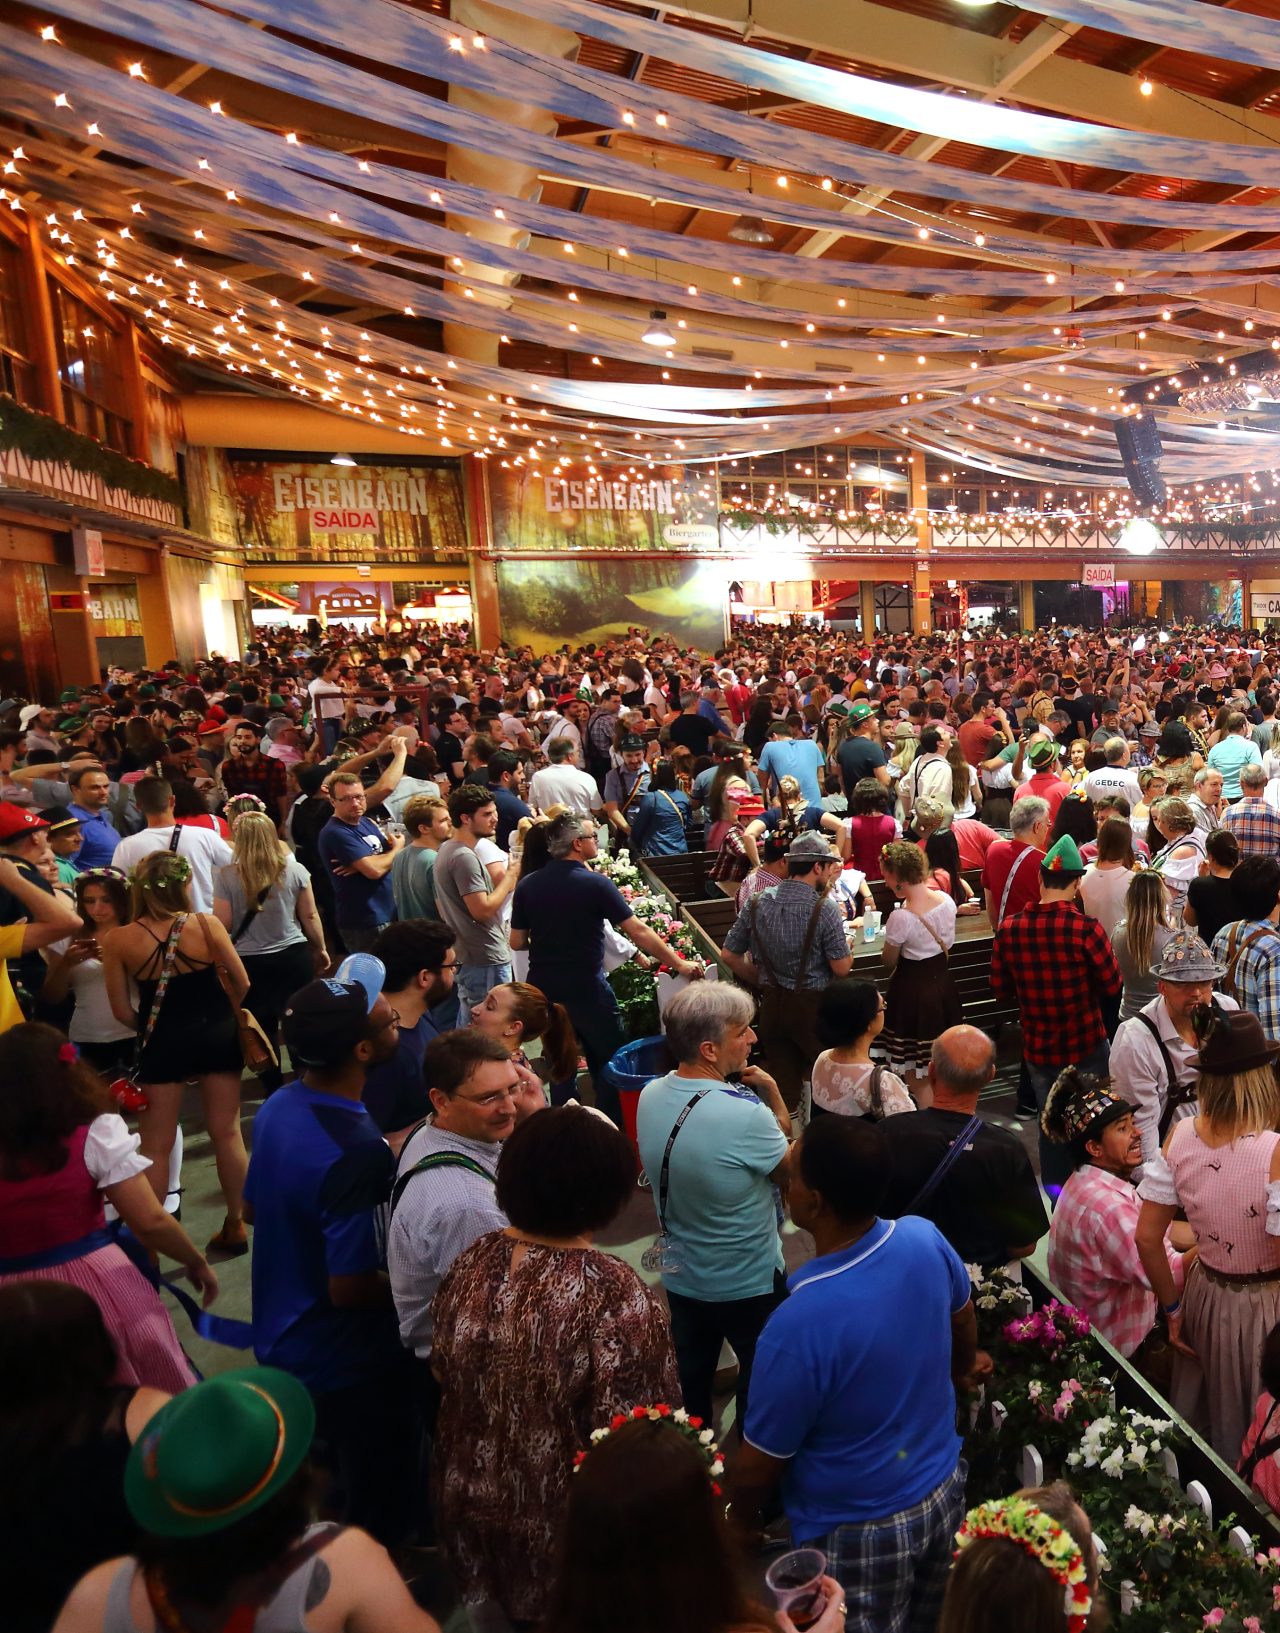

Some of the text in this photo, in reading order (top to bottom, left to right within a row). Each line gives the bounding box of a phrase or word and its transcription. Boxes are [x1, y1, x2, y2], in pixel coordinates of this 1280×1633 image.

[273, 472, 428, 516] EISENBAHN
[544, 476, 674, 515] EISENBAHN
[314, 509, 376, 528] SAÍDA
[1086, 566, 1112, 581] SAÍDA
[1095, 779, 1124, 787] GEDEC
